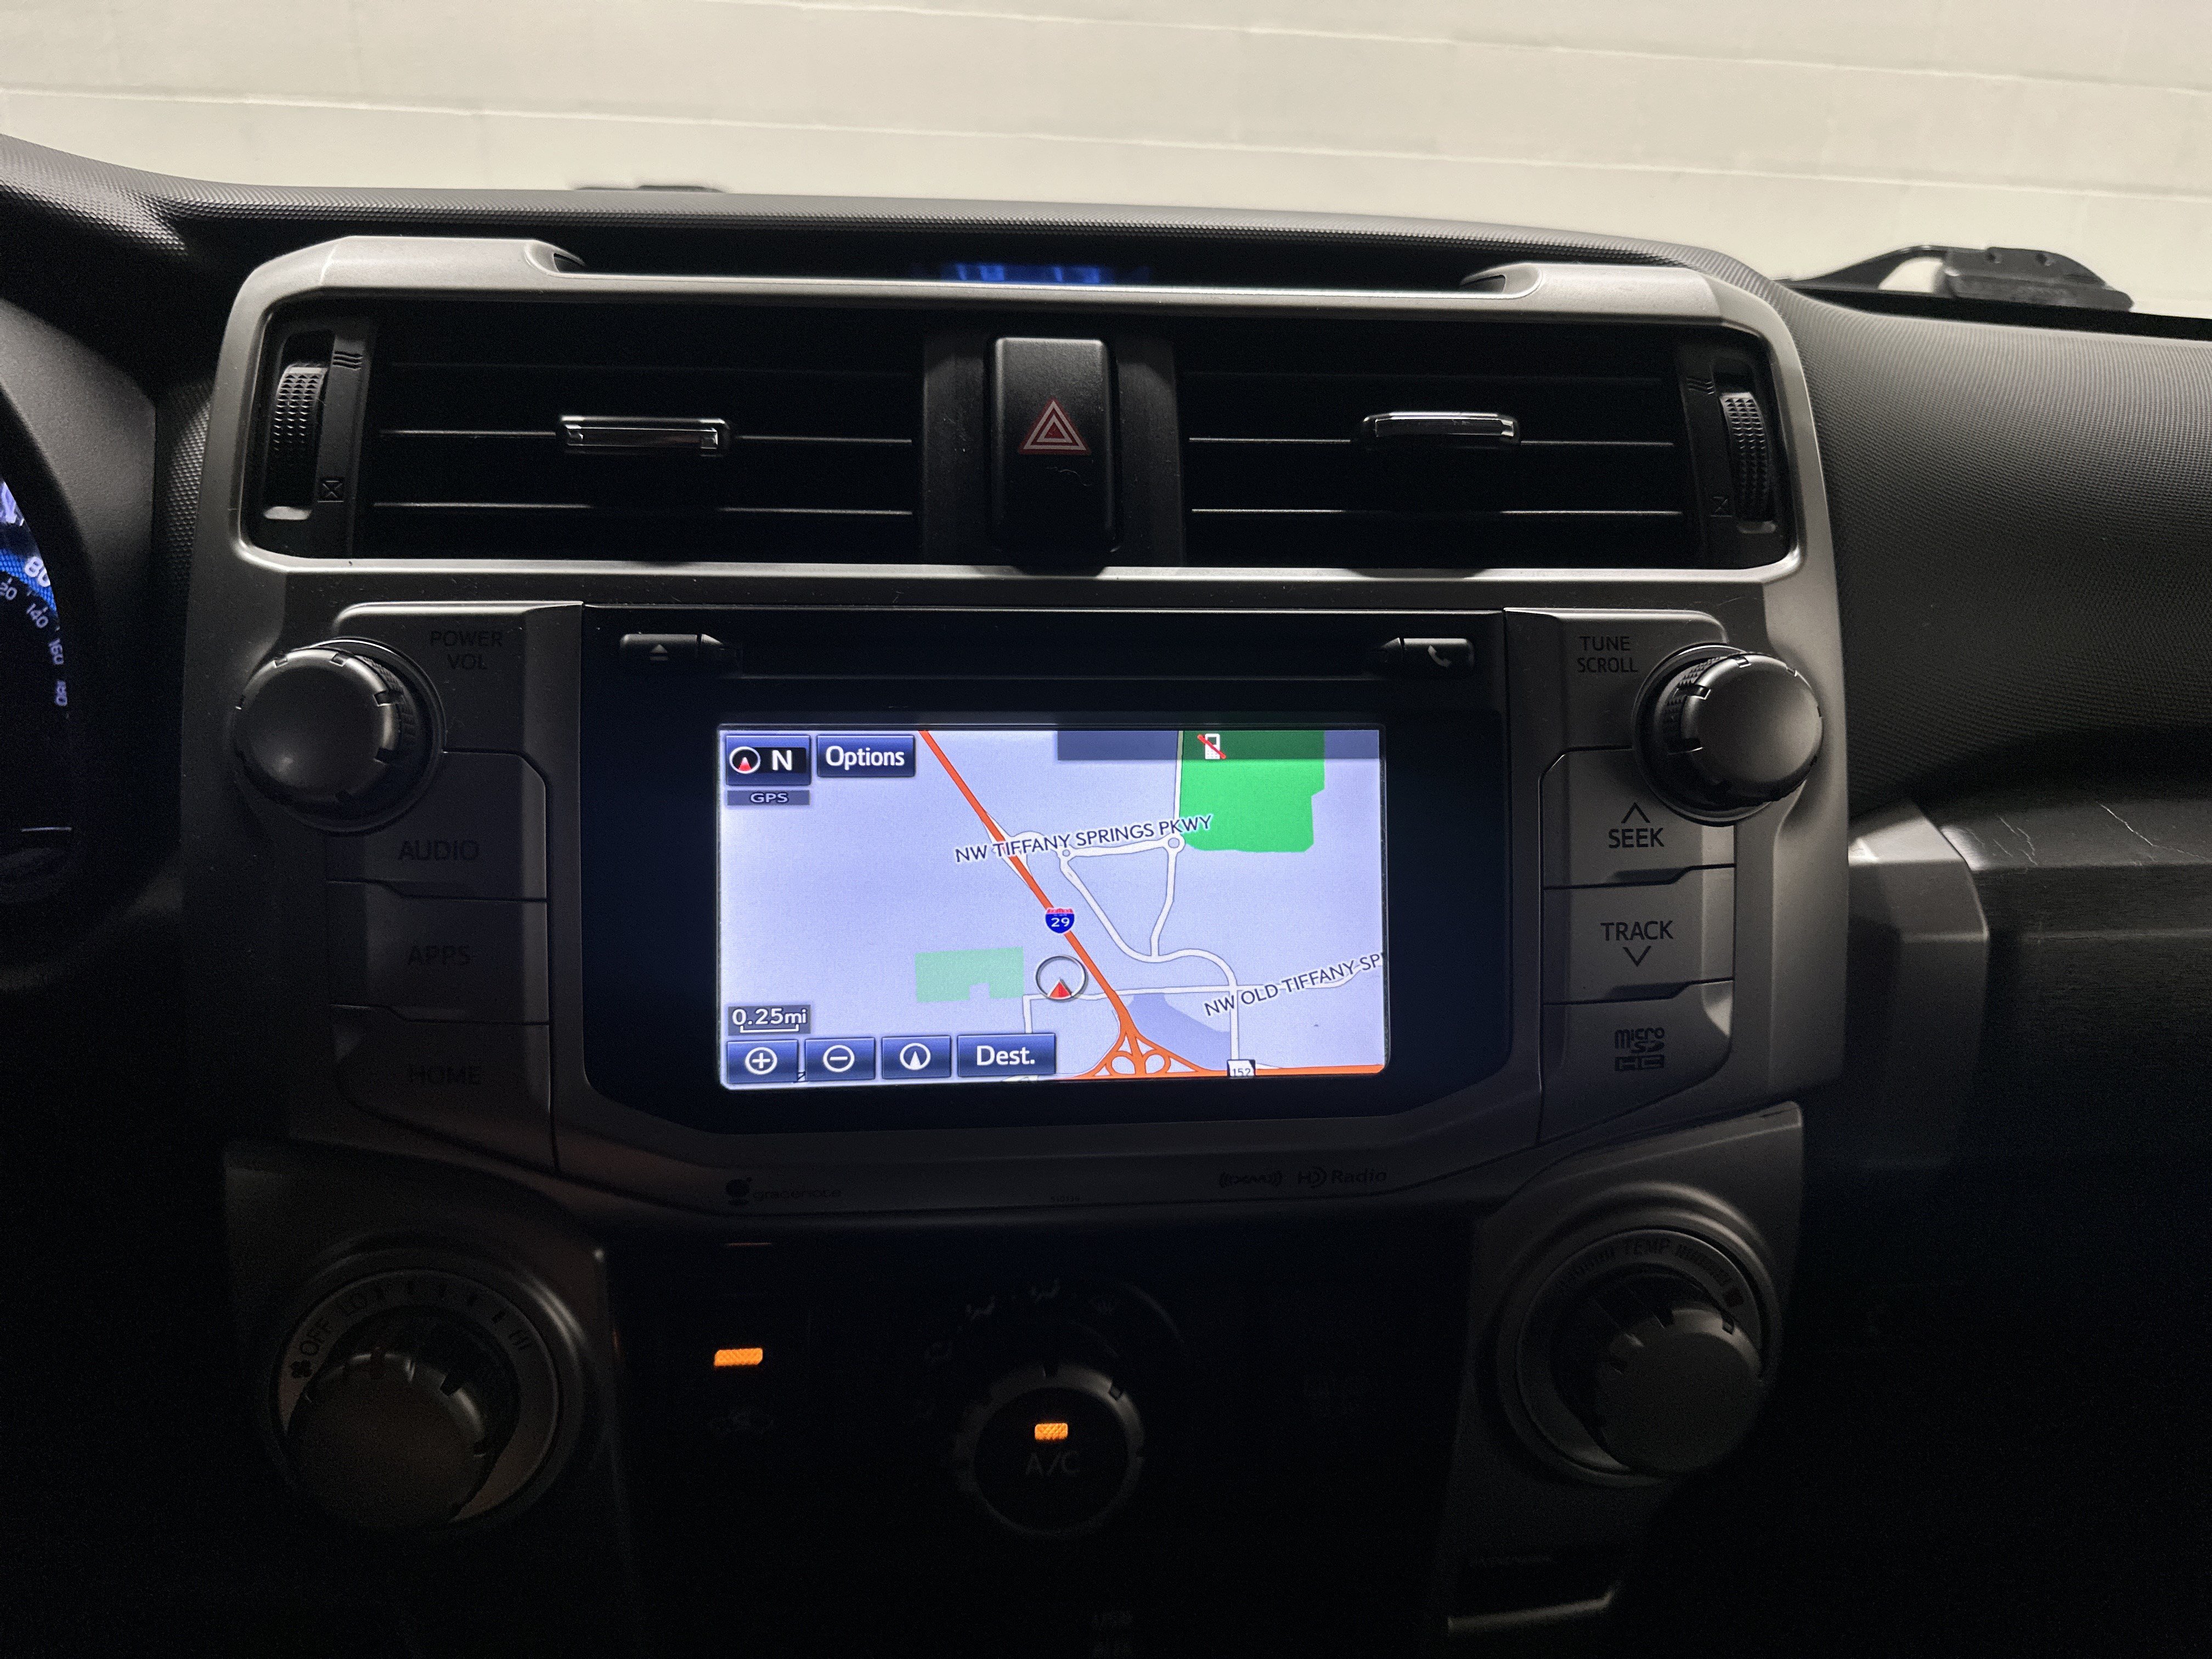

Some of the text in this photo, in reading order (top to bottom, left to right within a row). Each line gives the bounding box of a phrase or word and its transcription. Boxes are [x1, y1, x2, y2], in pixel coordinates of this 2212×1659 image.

[25, 556, 50, 587] 80
[26, 603, 48, 628] 140
[430, 631, 503, 647] POWER
[1579, 636, 1631, 651] TUNE
[447, 653, 487, 670] VOL
[1576, 657, 1638, 673] SCROLL
[772, 749, 792, 771] N
[825, 745, 905, 771] Options
[750, 792, 788, 803] GPS
[955, 815, 1212, 863] NW TIFFANY SPRINGS PKWY
[1608, 827, 1665, 849] SEEK
[398, 839, 479, 861] AUDIO
[1051, 917, 1070, 927] 29
[1600, 919, 1674, 941] TRACK
[408, 945, 471, 966] APPS
[1204, 952, 1383, 1017] NW OLD TIFFANY SP
[732, 1008, 807, 1025] 0.25mi
[976, 1045, 1036, 1066] Dest.
[409, 1064, 482, 1086] HOME
[1232, 1068, 1251, 1077] 152
[1331, 1167, 1387, 1184] Radio
[298, 1317, 334, 1356] OFF
[1024, 1449, 1081, 1479] A/C
